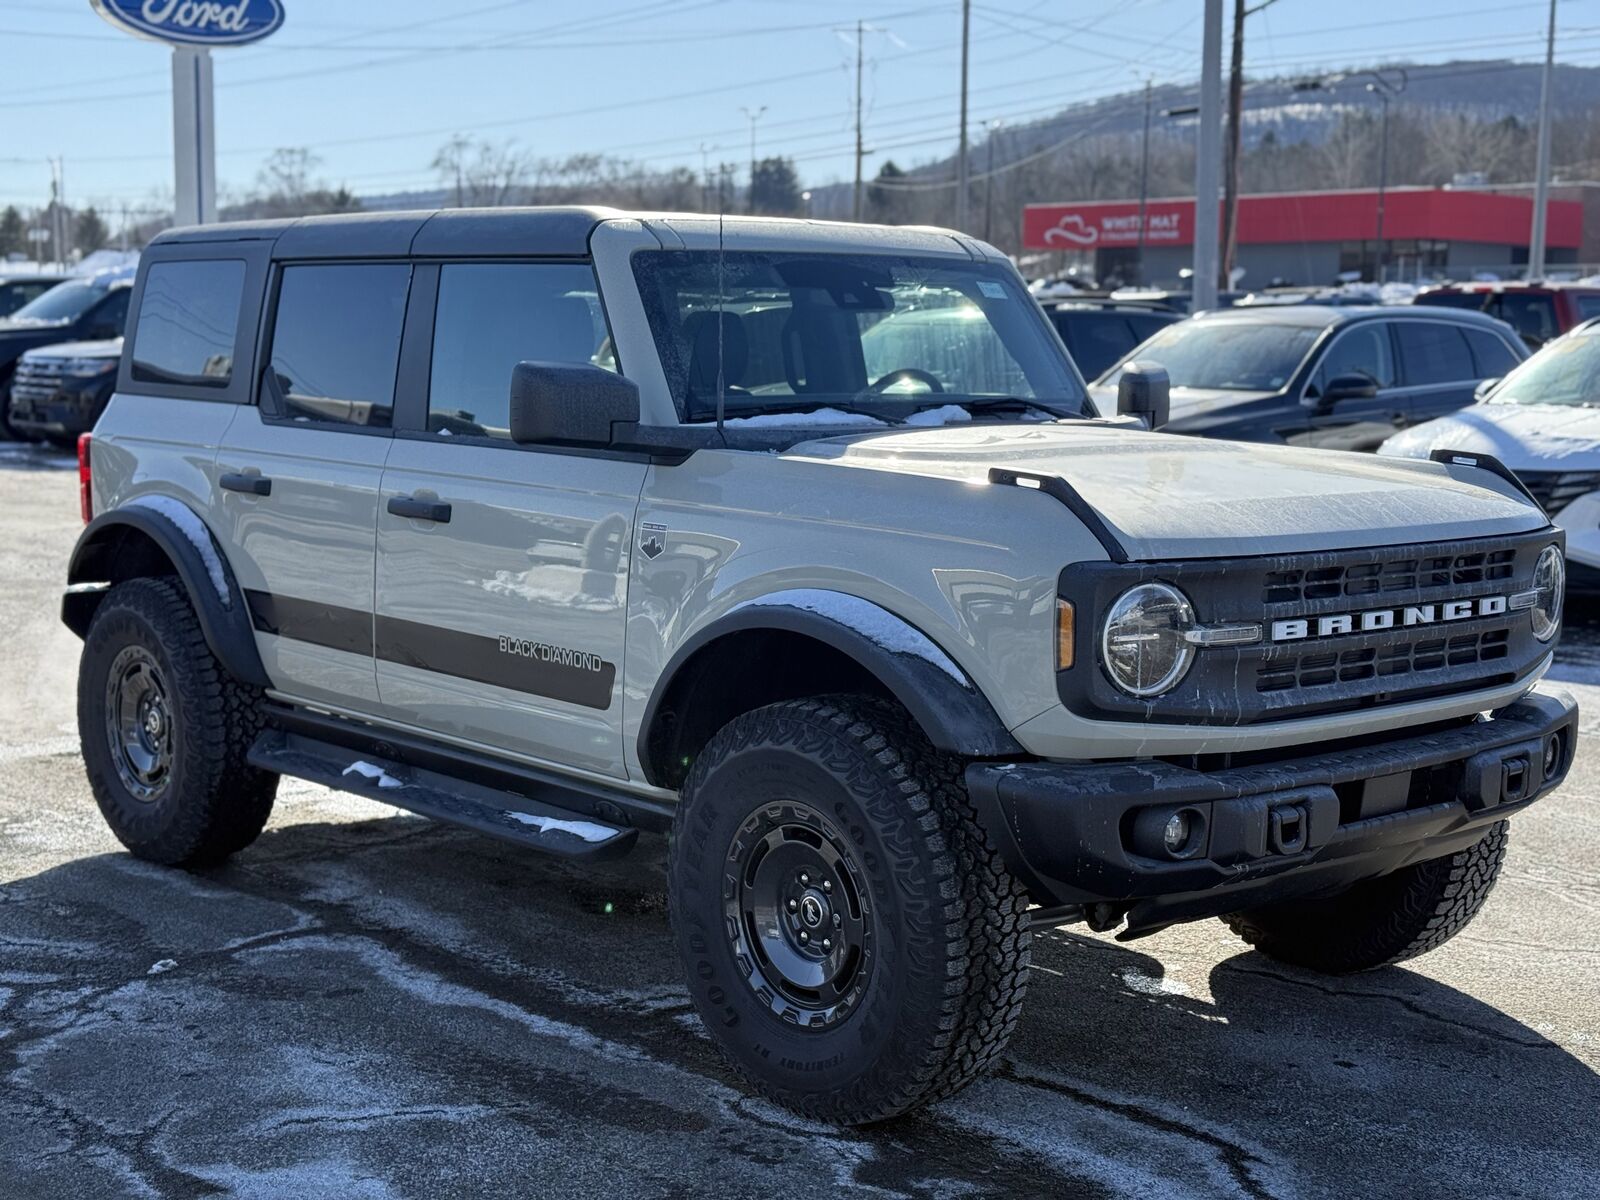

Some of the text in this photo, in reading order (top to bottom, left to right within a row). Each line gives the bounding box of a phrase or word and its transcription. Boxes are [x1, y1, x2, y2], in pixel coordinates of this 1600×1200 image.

[1150, 213, 1180, 229] HAT
[1272, 596, 1507, 641] BRONCO
[499, 636, 602, 672] BLACK DIAMOND
[779, 1051, 844, 1073] TERRITORY
